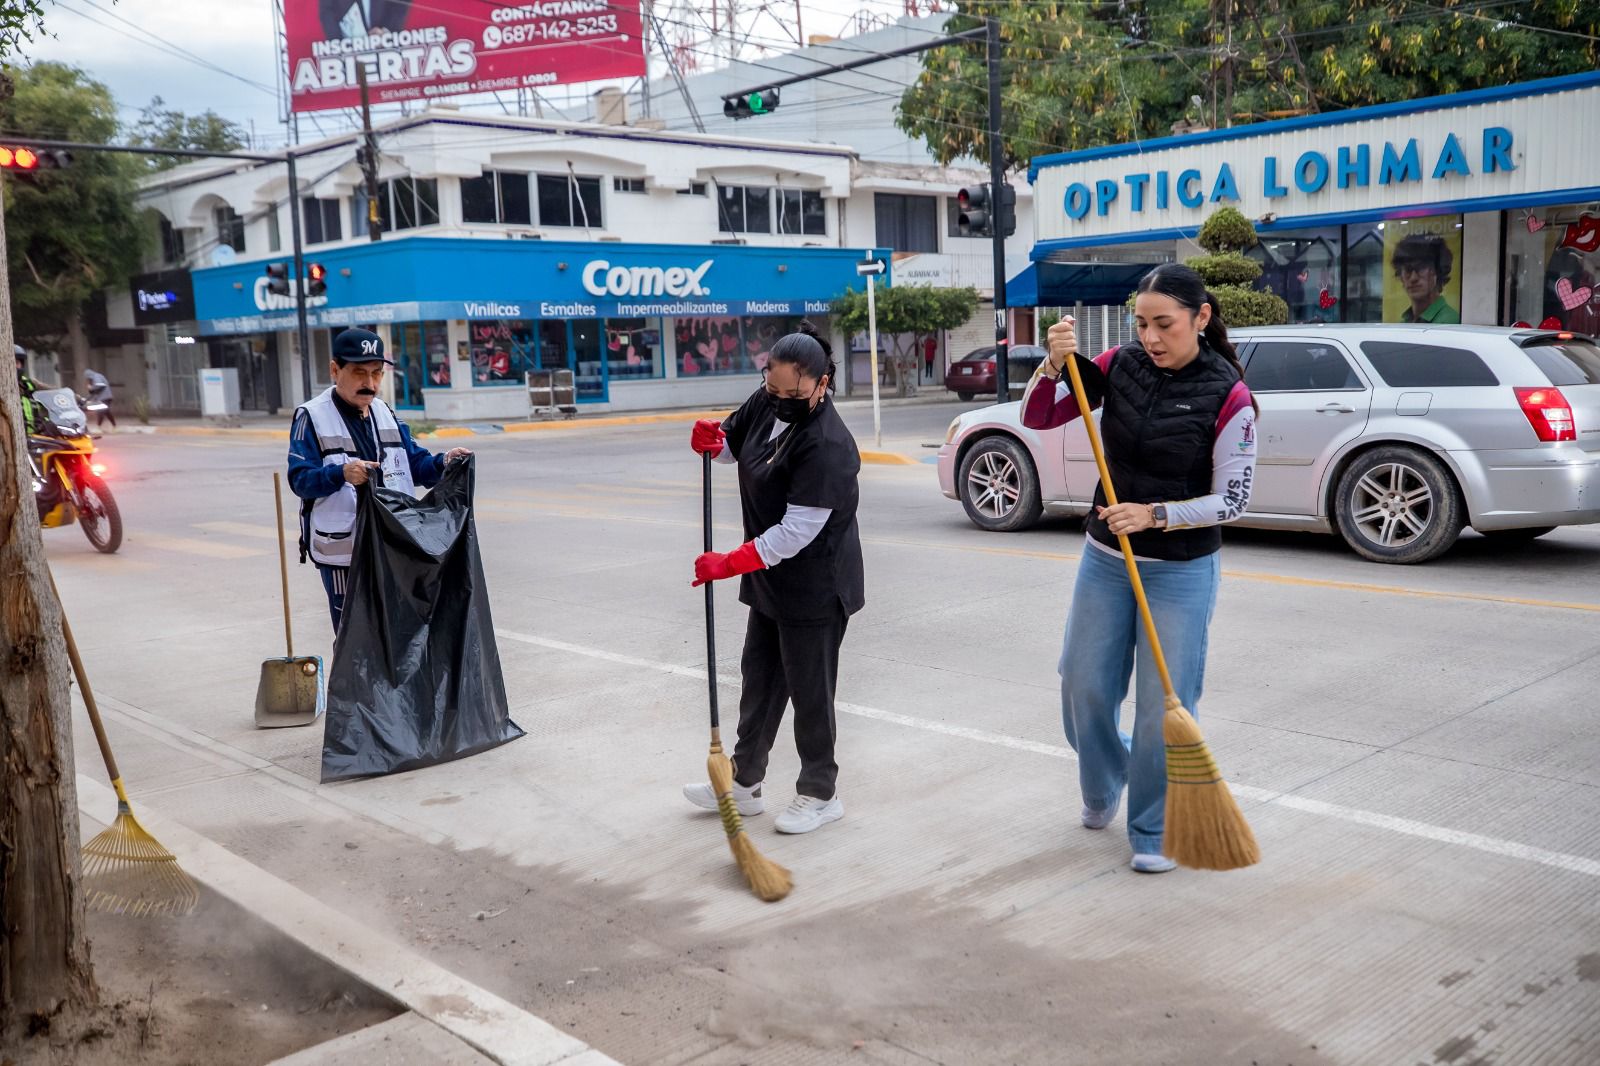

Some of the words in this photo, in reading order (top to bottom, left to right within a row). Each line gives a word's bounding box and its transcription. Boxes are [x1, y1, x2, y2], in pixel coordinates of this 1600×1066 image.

[312, 26, 447, 57] INSCRIPCIONES
[502, 14, 618, 44] 687-142-5253
[292, 40, 476, 92] ABIERTAS
[380, 87, 421, 99] SIEMPRE
[423, 82, 470, 96] GRANDES
[477, 76, 519, 90] SIEMPRE
[522, 72, 557, 85] LOBOS
[1063, 161, 1241, 221] OPTICA
[1263, 126, 1518, 199] LOHMAR
[582, 259, 714, 297] Comex
[540, 301, 596, 316] Esmaltes
[617, 301, 728, 317] Impermeabilizantes
[746, 301, 790, 314] Maderas
[804, 301, 832, 313] Indus
[361, 340, 379, 355] M
